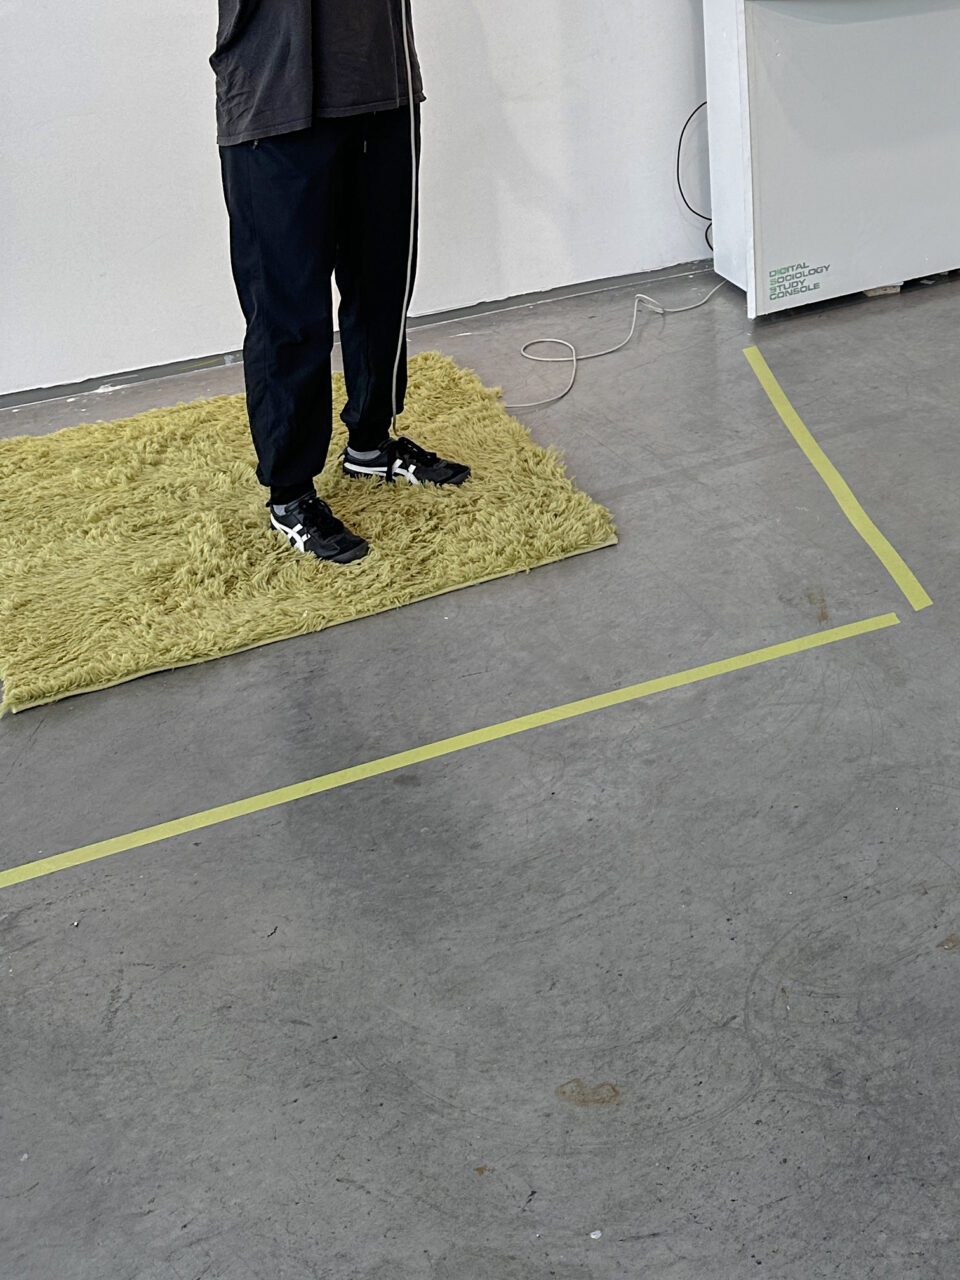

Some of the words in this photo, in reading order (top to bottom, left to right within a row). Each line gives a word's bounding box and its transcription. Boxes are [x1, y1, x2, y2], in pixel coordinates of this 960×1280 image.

[769, 262, 810, 278] DIGITAL
[769, 264, 831, 286] SOCIOLOGY
[769, 278, 806, 294] STUDY
[769, 282, 820, 300] CONSOLE
